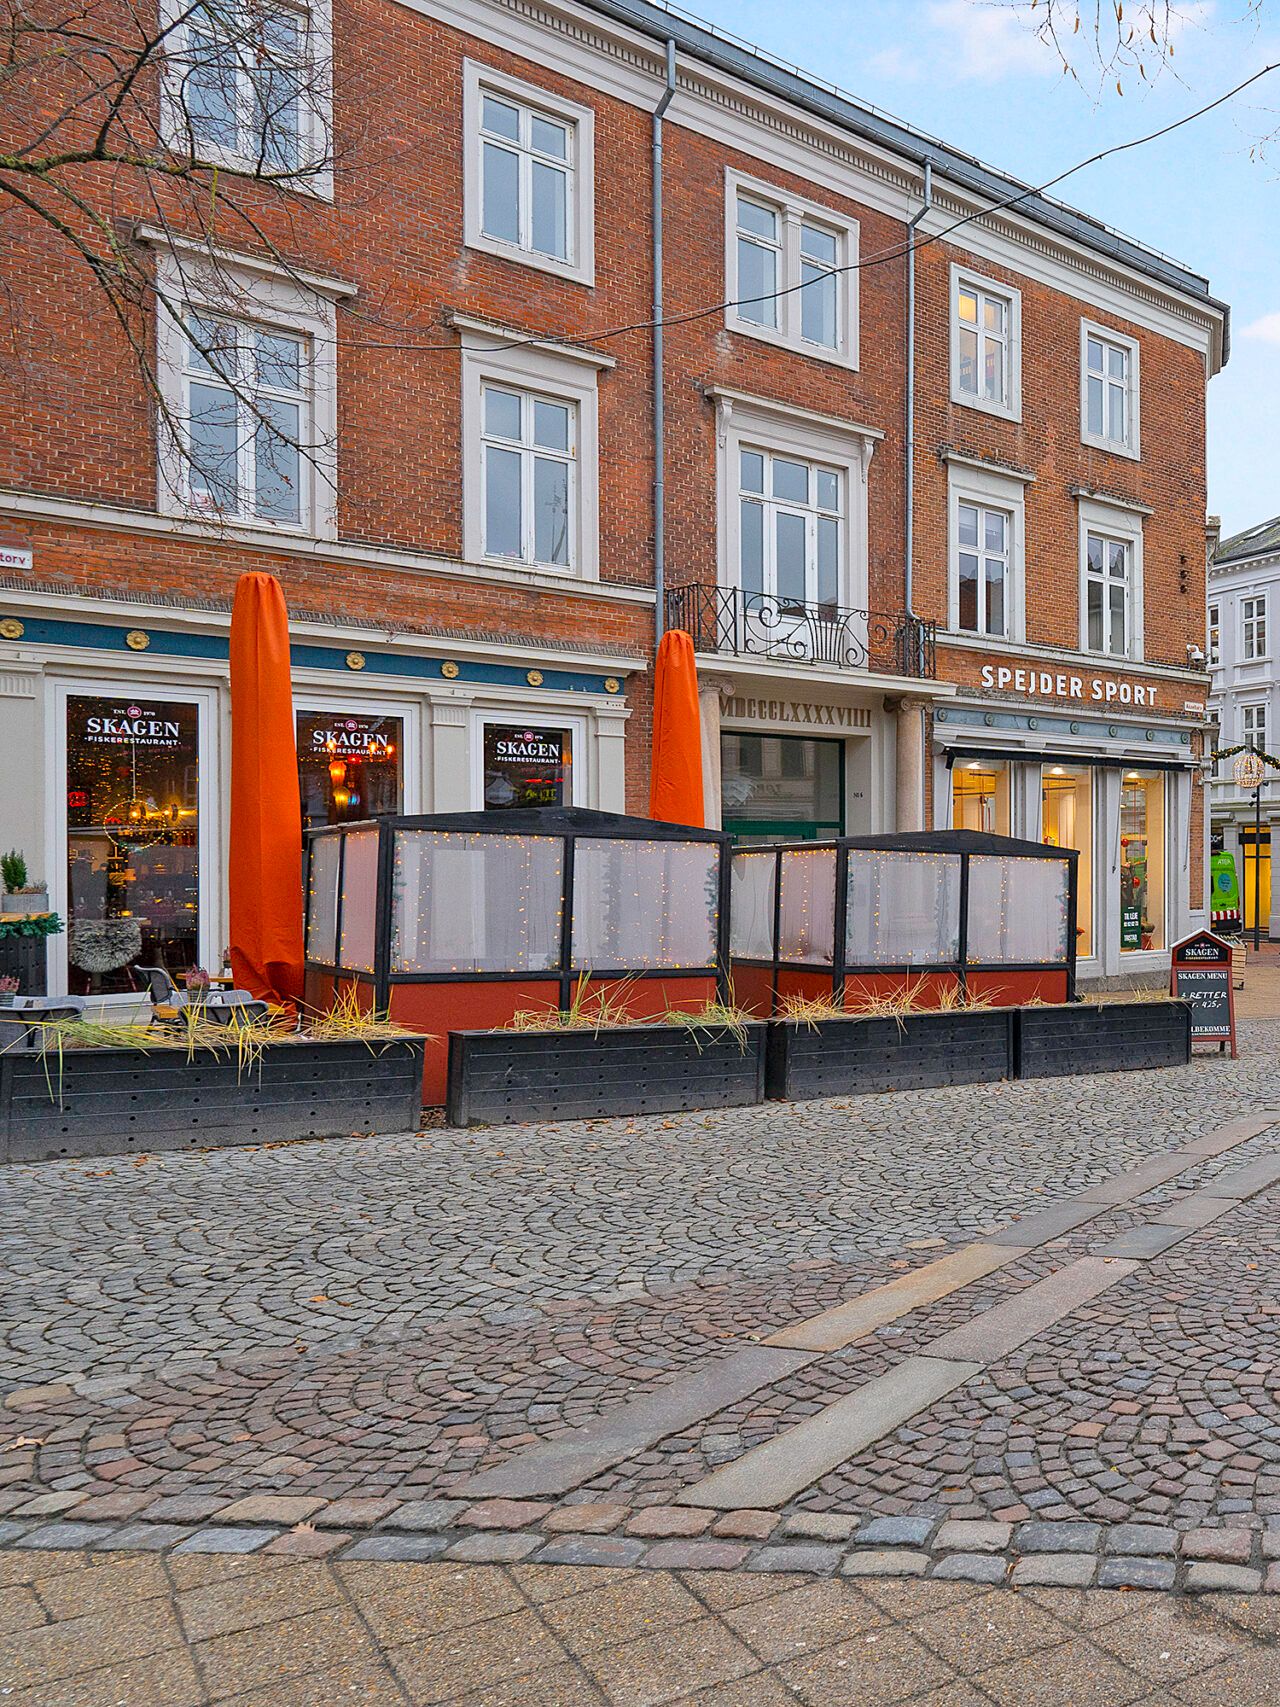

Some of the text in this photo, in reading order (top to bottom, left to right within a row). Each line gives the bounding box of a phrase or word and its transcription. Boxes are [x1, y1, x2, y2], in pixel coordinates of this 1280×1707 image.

[981, 665, 1158, 706] SPEJDER SPORT
[87, 717, 180, 737] SKAGEN
[87, 735, 178, 746] FISKERESTAURANT
[312, 730, 389, 747] SKAGEN
[496, 741, 560, 757] SKAGEN
[497, 756, 558, 764] FISKERESTAURANT
[1185, 948, 1219, 956] SKAGEN
[1178, 972, 1228, 980] SKAGEN MENU
[1189, 991, 1227, 999] RETTER
